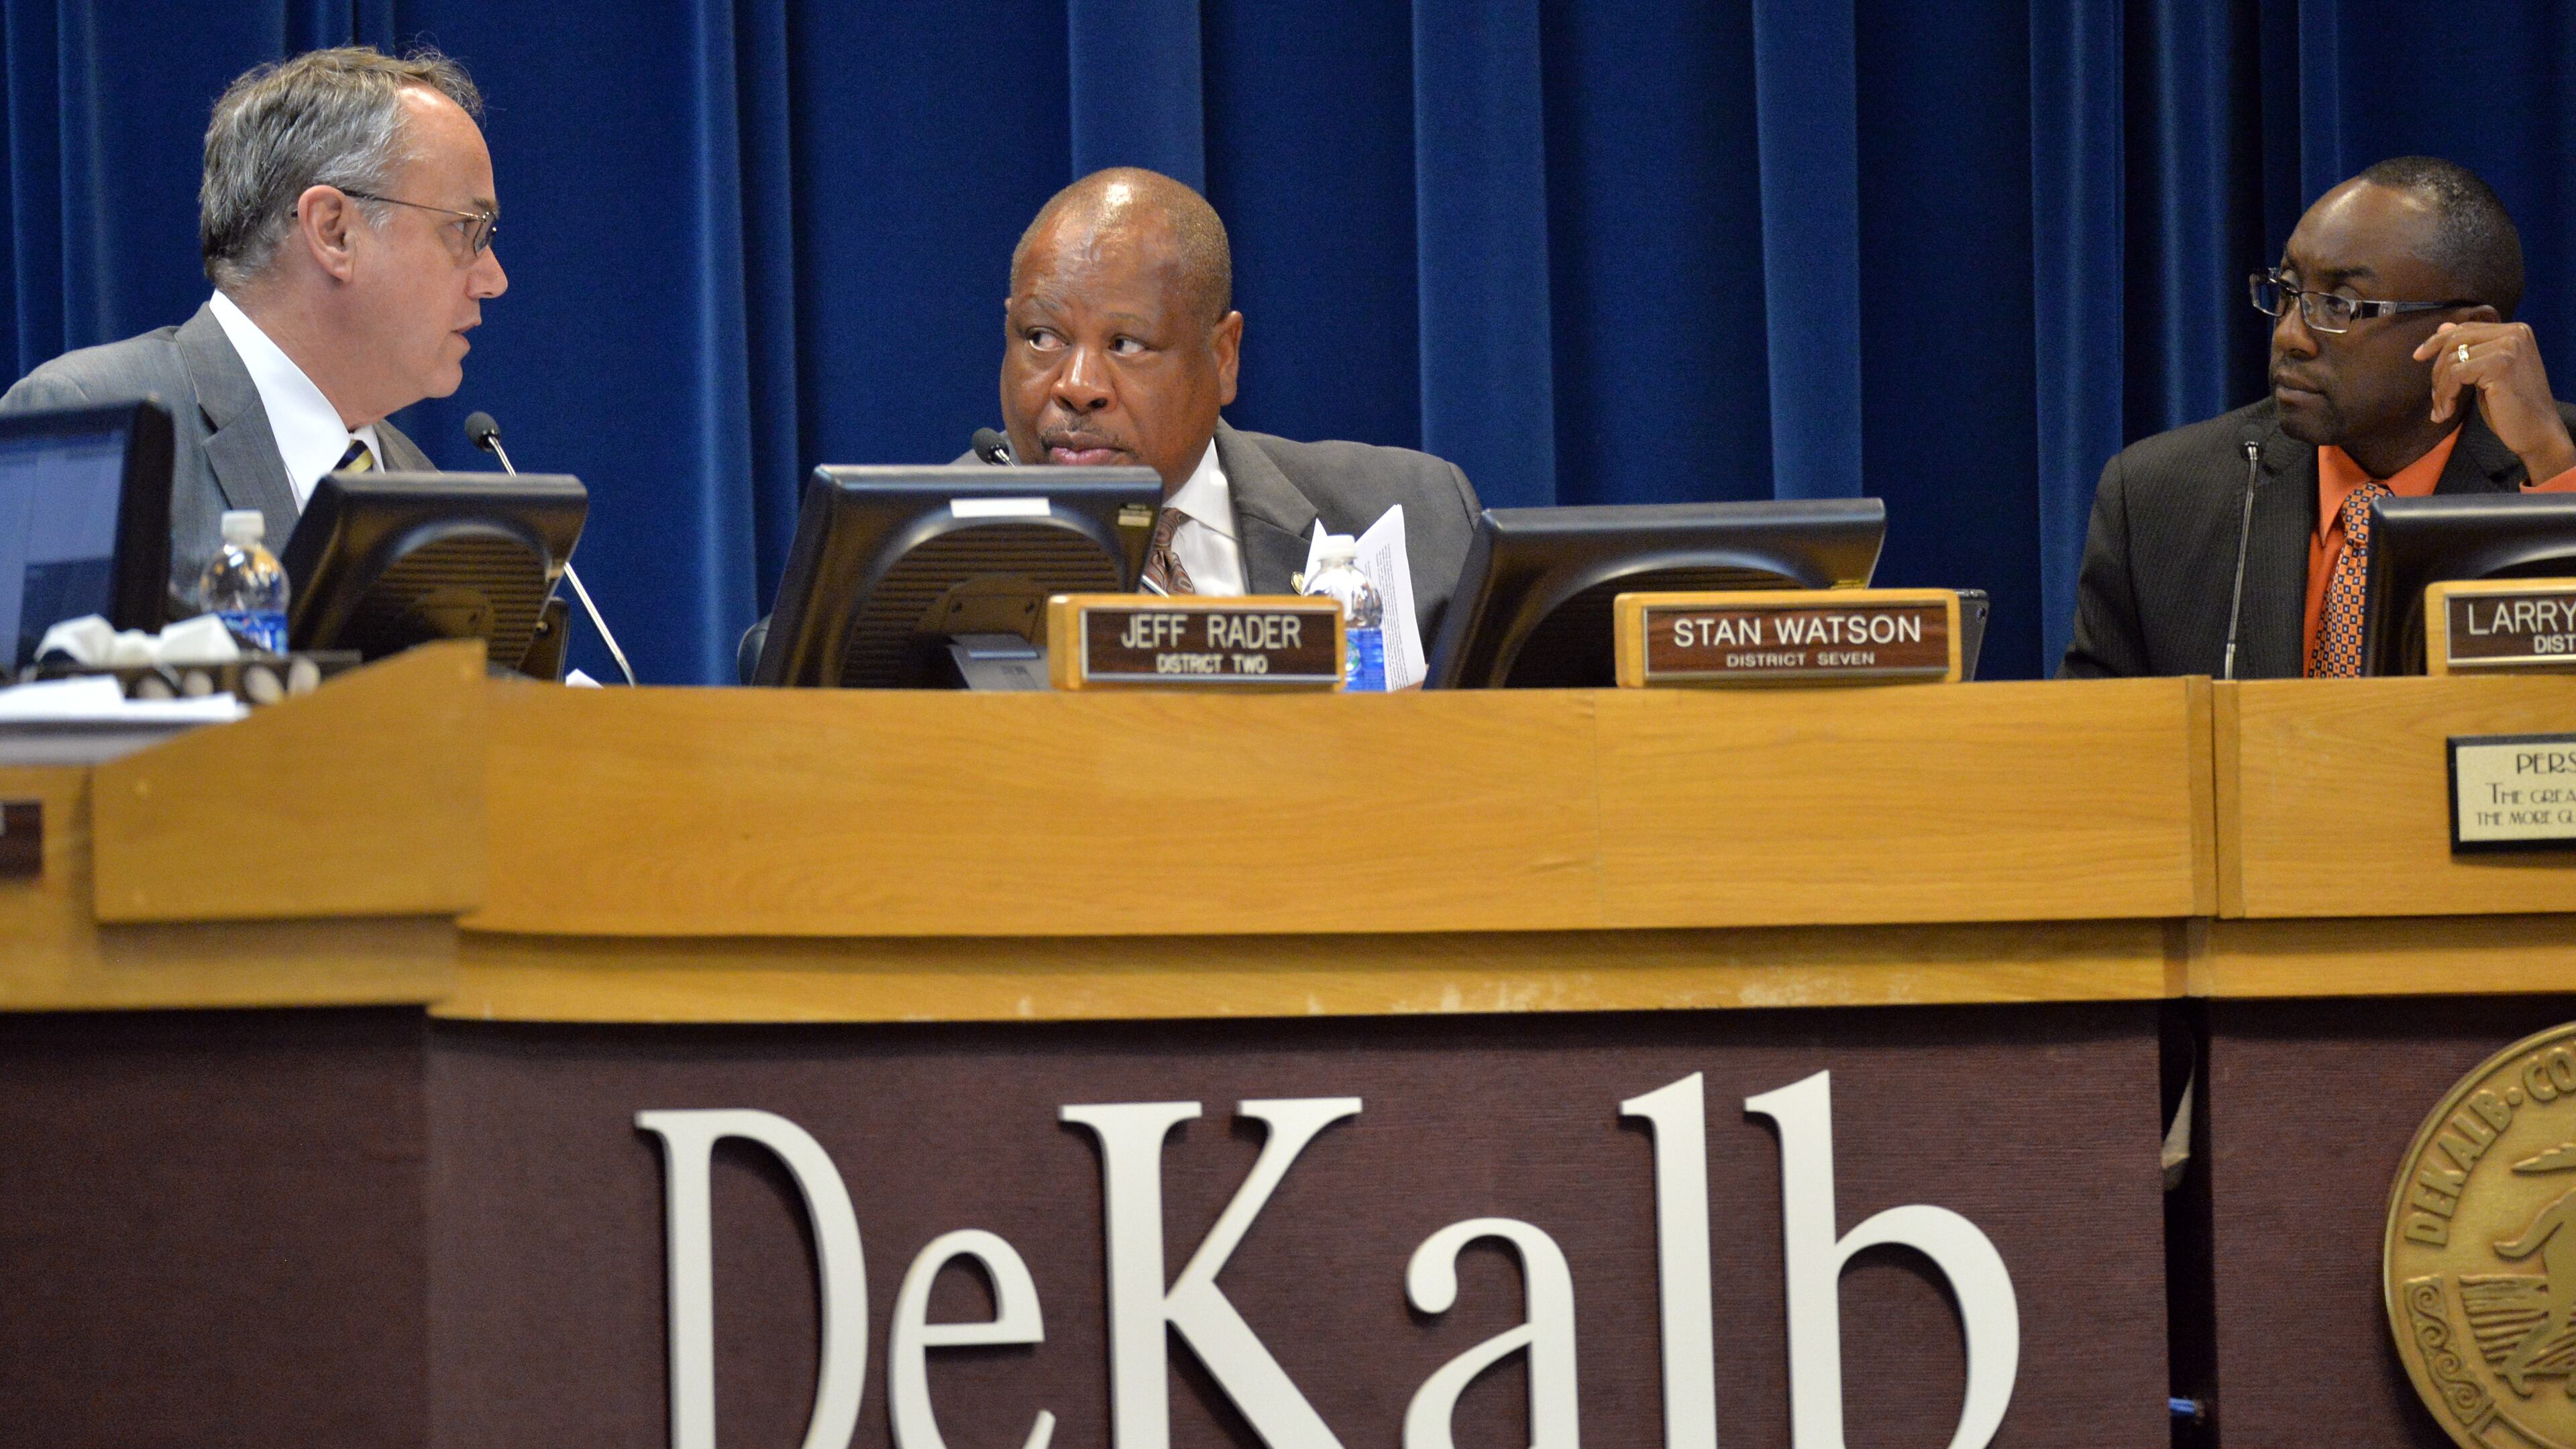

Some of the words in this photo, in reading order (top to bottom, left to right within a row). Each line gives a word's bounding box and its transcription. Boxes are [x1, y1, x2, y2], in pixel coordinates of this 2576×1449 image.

[1121, 614, 1188, 649] JEFF
[1208, 614, 1302, 649] RADER
[1674, 617, 1762, 647] STAN
[1774, 614, 1921, 645] WATSON
[2468, 600, 2576, 635] LARRY
[1726, 652, 1806, 668] DISTRICT
[1817, 651, 1875, 666] SEVEN
[2533, 633, 2576, 654] DIST
[1157, 653, 1224, 674] DISTRICT
[1232, 653, 1268, 674] TWO
[2404, 1088, 2513, 1247] DEKALB
[634, 1069, 2021, 1449] DeKalb
